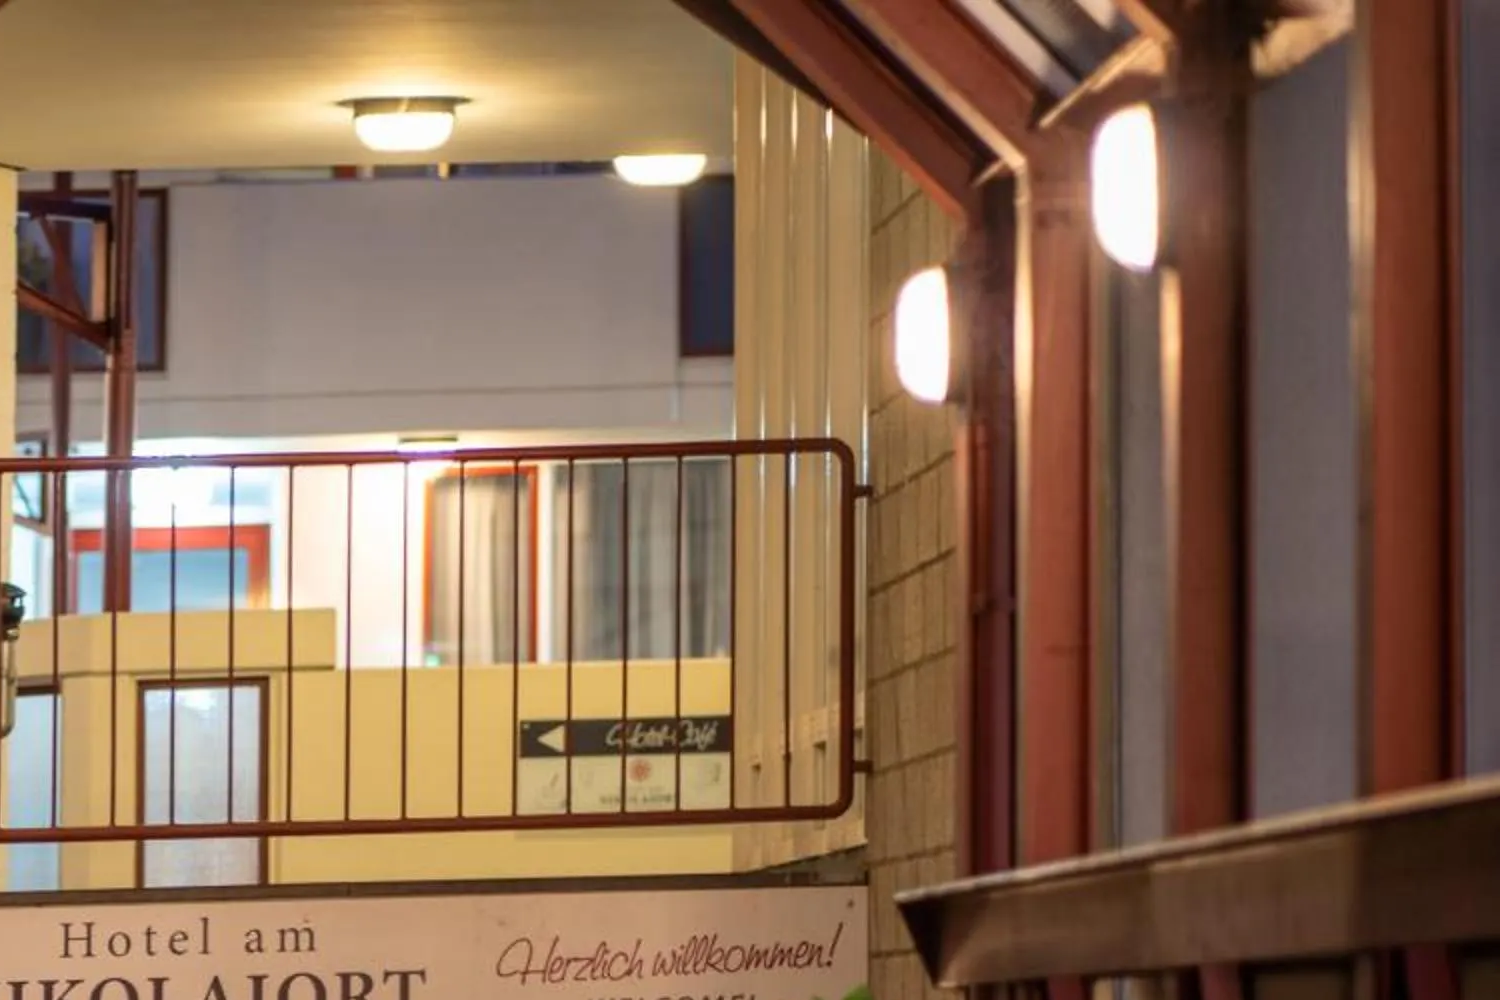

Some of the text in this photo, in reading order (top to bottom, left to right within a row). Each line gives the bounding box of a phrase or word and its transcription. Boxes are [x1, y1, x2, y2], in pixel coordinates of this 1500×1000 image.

[59, 917, 317, 960] Hotel am
[496, 922, 844, 986] Herzlich willkommen!
